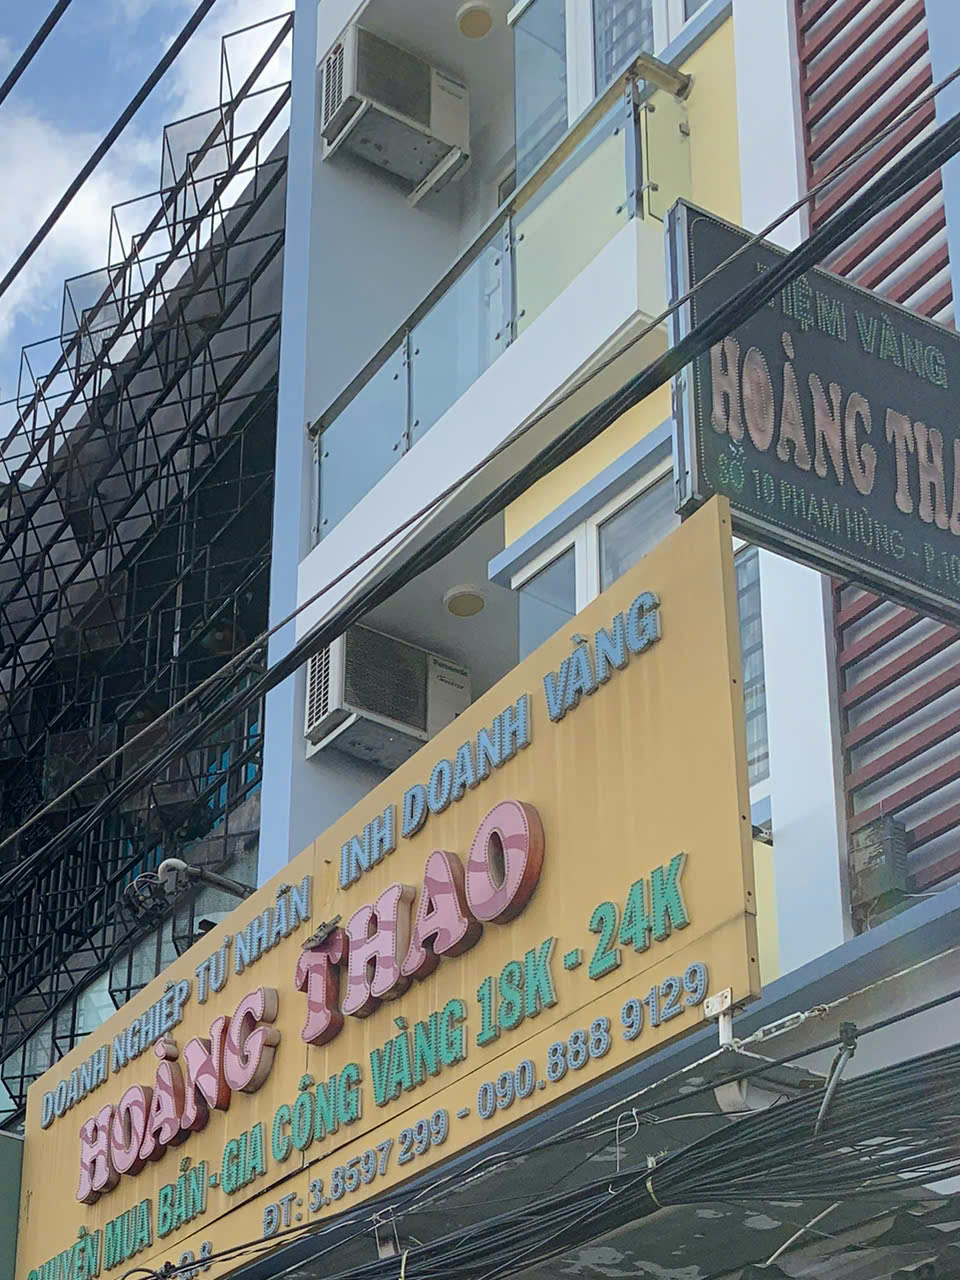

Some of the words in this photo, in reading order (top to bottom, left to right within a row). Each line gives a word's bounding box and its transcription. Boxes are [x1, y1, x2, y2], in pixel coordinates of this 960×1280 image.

[710, 331, 877, 496] HOÀNG
[757, 262, 847, 341] IỆM
[856, 313, 948, 388] VÀNG
[718, 439, 746, 490] SỐ
[750, 467, 775, 504] 10
[780, 480, 841, 535] PHẠM
[846, 503, 907, 561] HÙNG
[40, 1044, 110, 1130] DOANH
[112, 979, 192, 1073] NGHIỆP
[195, 935, 232, 1005] TƯ
[234, 875, 314, 974] NHÂN
[339, 804, 397, 889] INH
[401, 693, 532, 839] DOANH
[543, 591, 662, 723] VÀNG
[76, 986, 281, 1204] HOÀNG
[104, 1198, 152, 1270] MUA
[222, 1122, 267, 1194] GIA
[271, 1062, 362, 1163] CÔNG
[370, 998, 468, 1108] VÀNG
[477, 936, 558, 1047] 18K
[588, 851, 690, 980] 24K
[262, 1192, 303, 1238] ĐT:
[308, 1138, 393, 1213] 3.8597
[397, 1108, 448, 1165] 299
[478, 1016, 611, 1120] 090.888
[620, 962, 708, 1042] 9129
